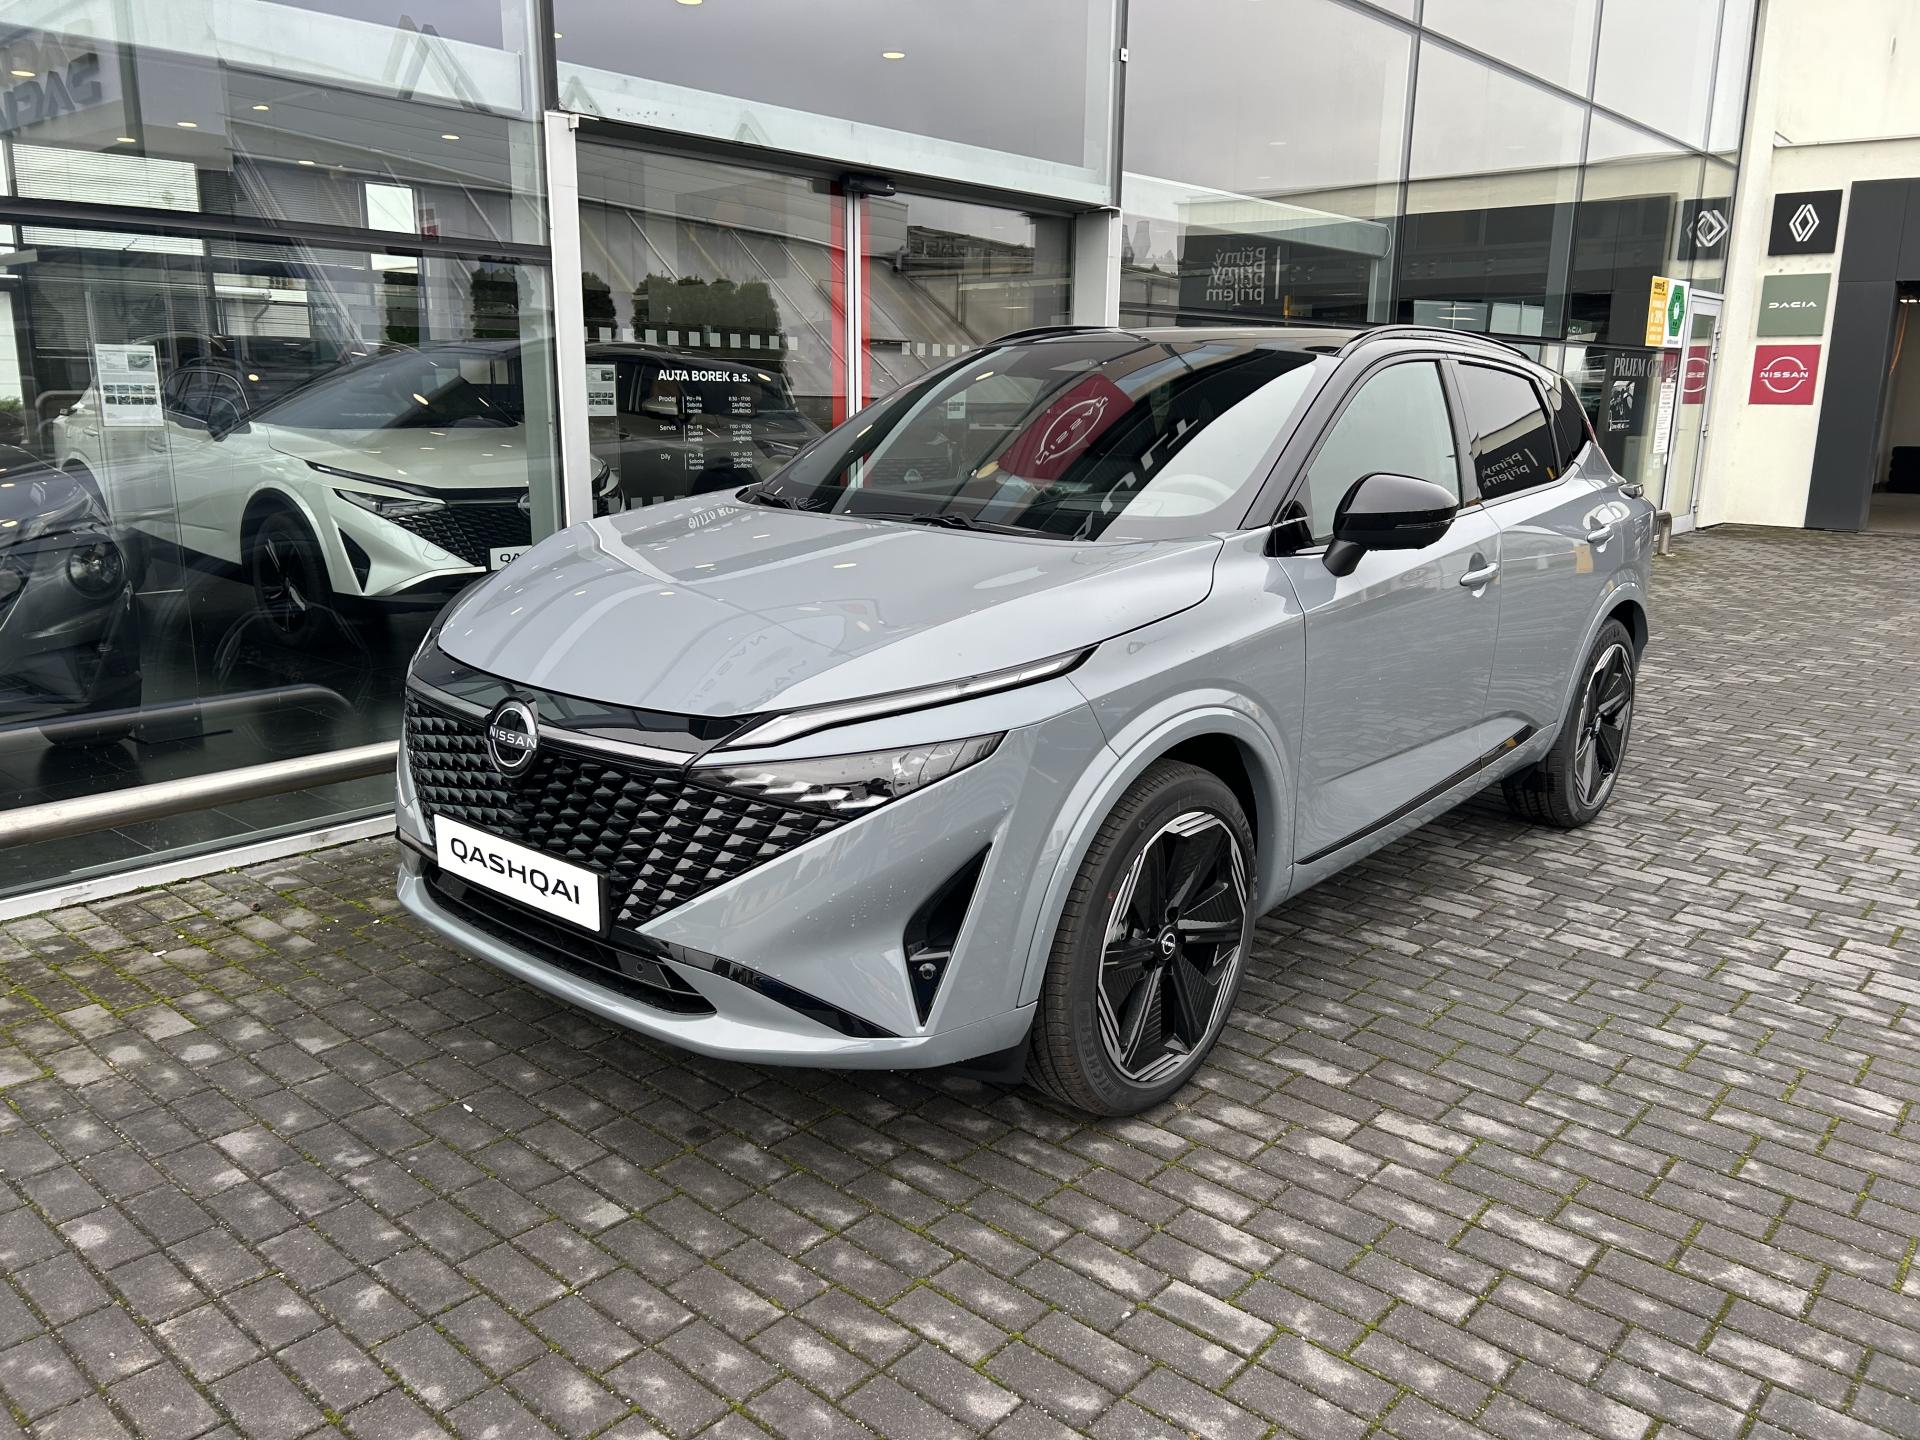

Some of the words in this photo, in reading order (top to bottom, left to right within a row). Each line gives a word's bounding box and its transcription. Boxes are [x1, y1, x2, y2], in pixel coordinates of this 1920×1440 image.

[1768, 301, 1817, 309] DACIA
[658, 369, 690, 381] AUTA
[691, 370, 731, 382] BOREK
[732, 373, 751, 383] a.s.
[489, 726, 538, 749] NISSAN
[450, 837, 580, 905] QASHQAI
